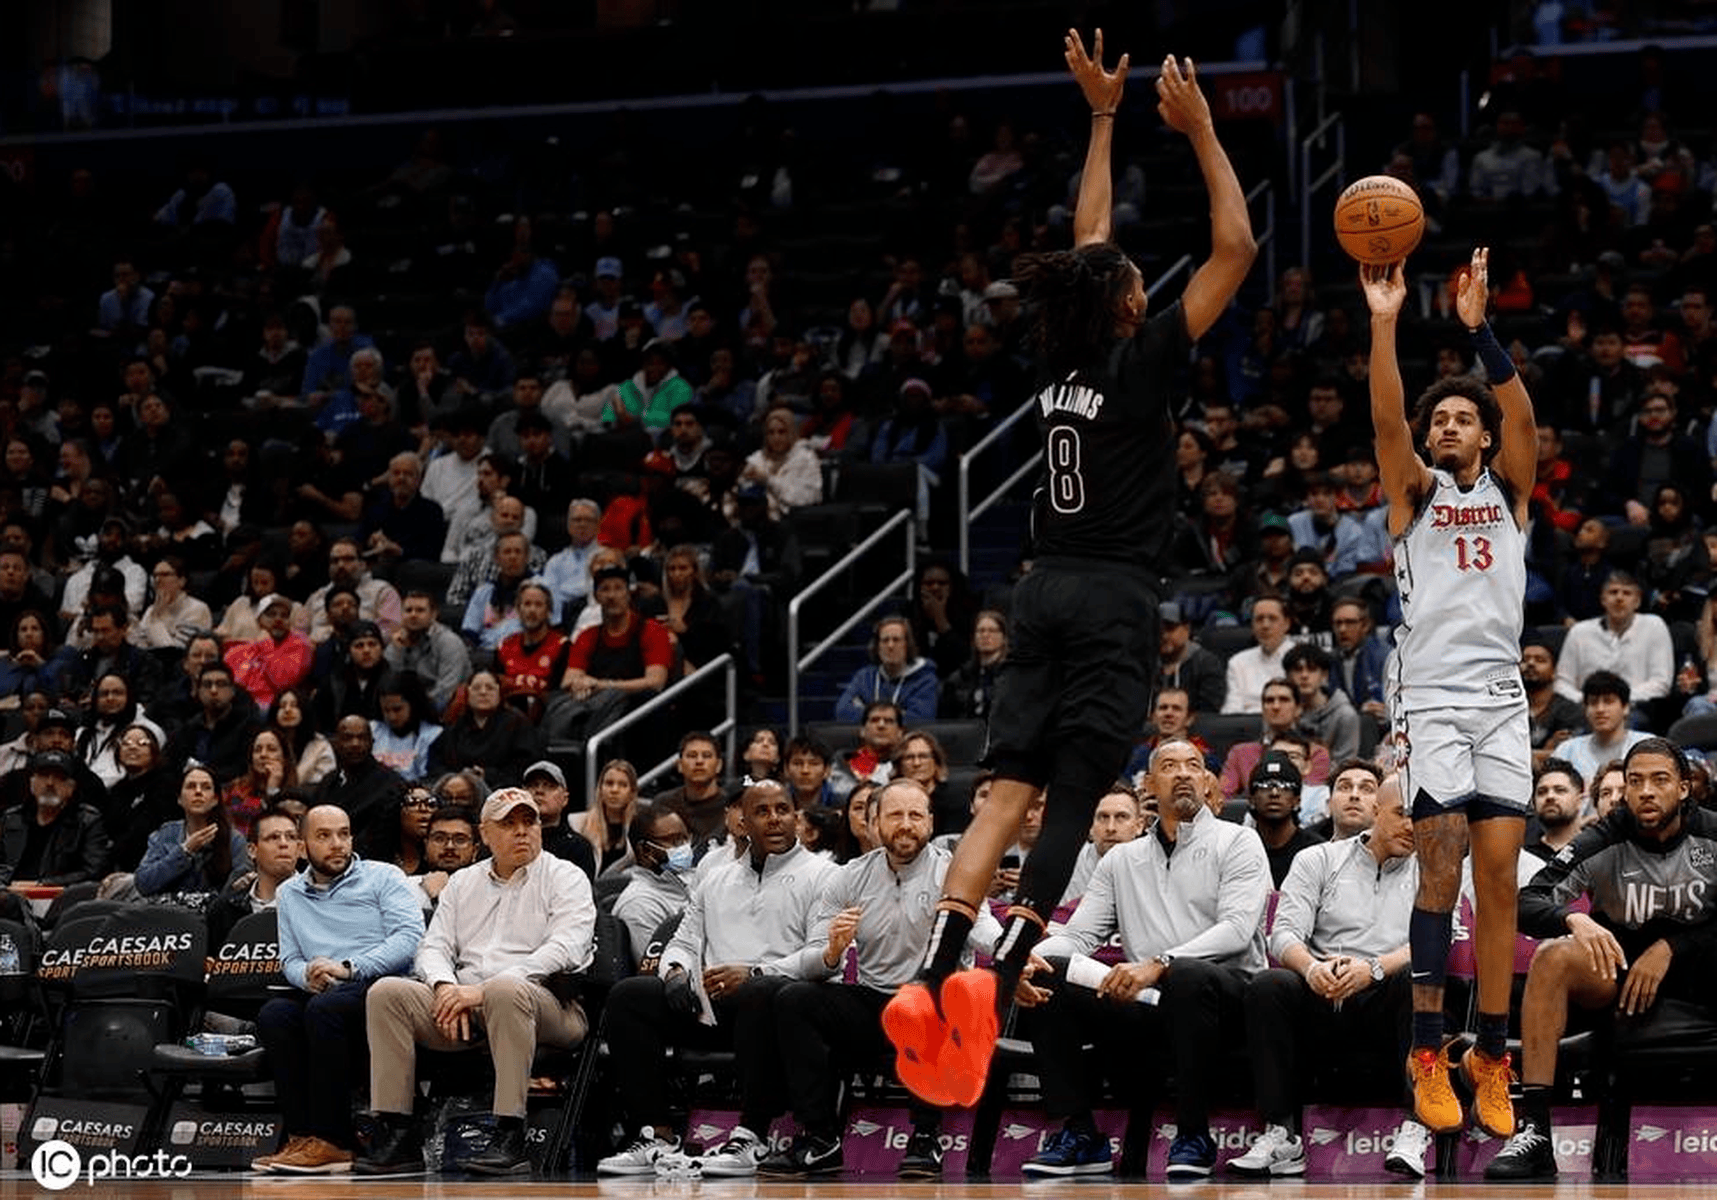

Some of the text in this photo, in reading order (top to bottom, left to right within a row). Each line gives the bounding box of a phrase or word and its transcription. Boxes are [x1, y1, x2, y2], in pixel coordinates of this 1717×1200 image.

[1225, 86, 1273, 112] 100
[1048, 425, 1085, 513] 8
[1431, 502, 1504, 528] Distric
[1454, 536, 1493, 571] 13
[1625, 880, 1705, 924] NETS
[88, 933, 193, 954] CAESARS
[219, 943, 281, 960] CAES
[82, 951, 170, 968] SPORTSBOOK
[213, 960, 282, 975] SPORTSBO
[36, 965, 78, 979] SPORT
[60, 1120, 133, 1139] CAESARS
[200, 1121, 275, 1137] CAESARS
[884, 1126, 968, 1152] leos
[1347, 1126, 1432, 1155] leid
